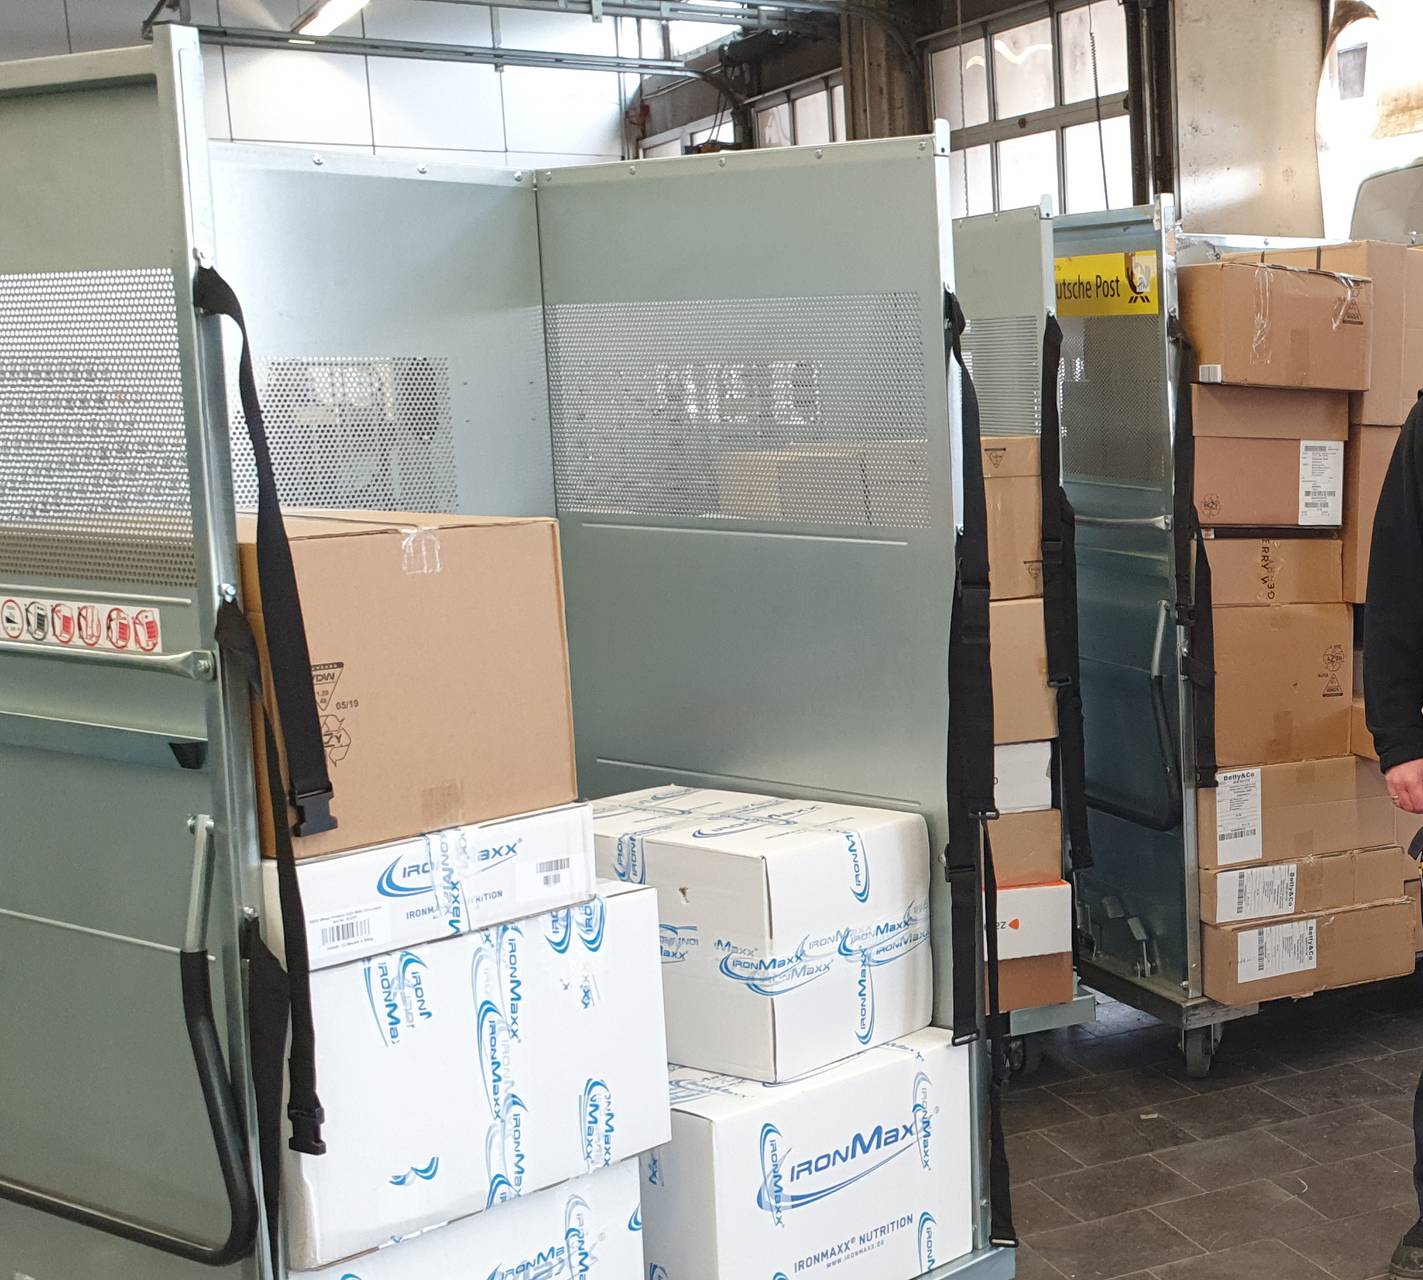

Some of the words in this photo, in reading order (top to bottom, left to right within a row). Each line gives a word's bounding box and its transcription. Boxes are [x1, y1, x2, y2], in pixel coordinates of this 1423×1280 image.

[1055, 274, 1092, 300] utsche
[1095, 274, 1121, 299] Post
[336, 700, 359, 711] 05/19
[793, 1240, 851, 1273] IRONMAXX
[859, 1213, 914, 1246] NUTRITION
